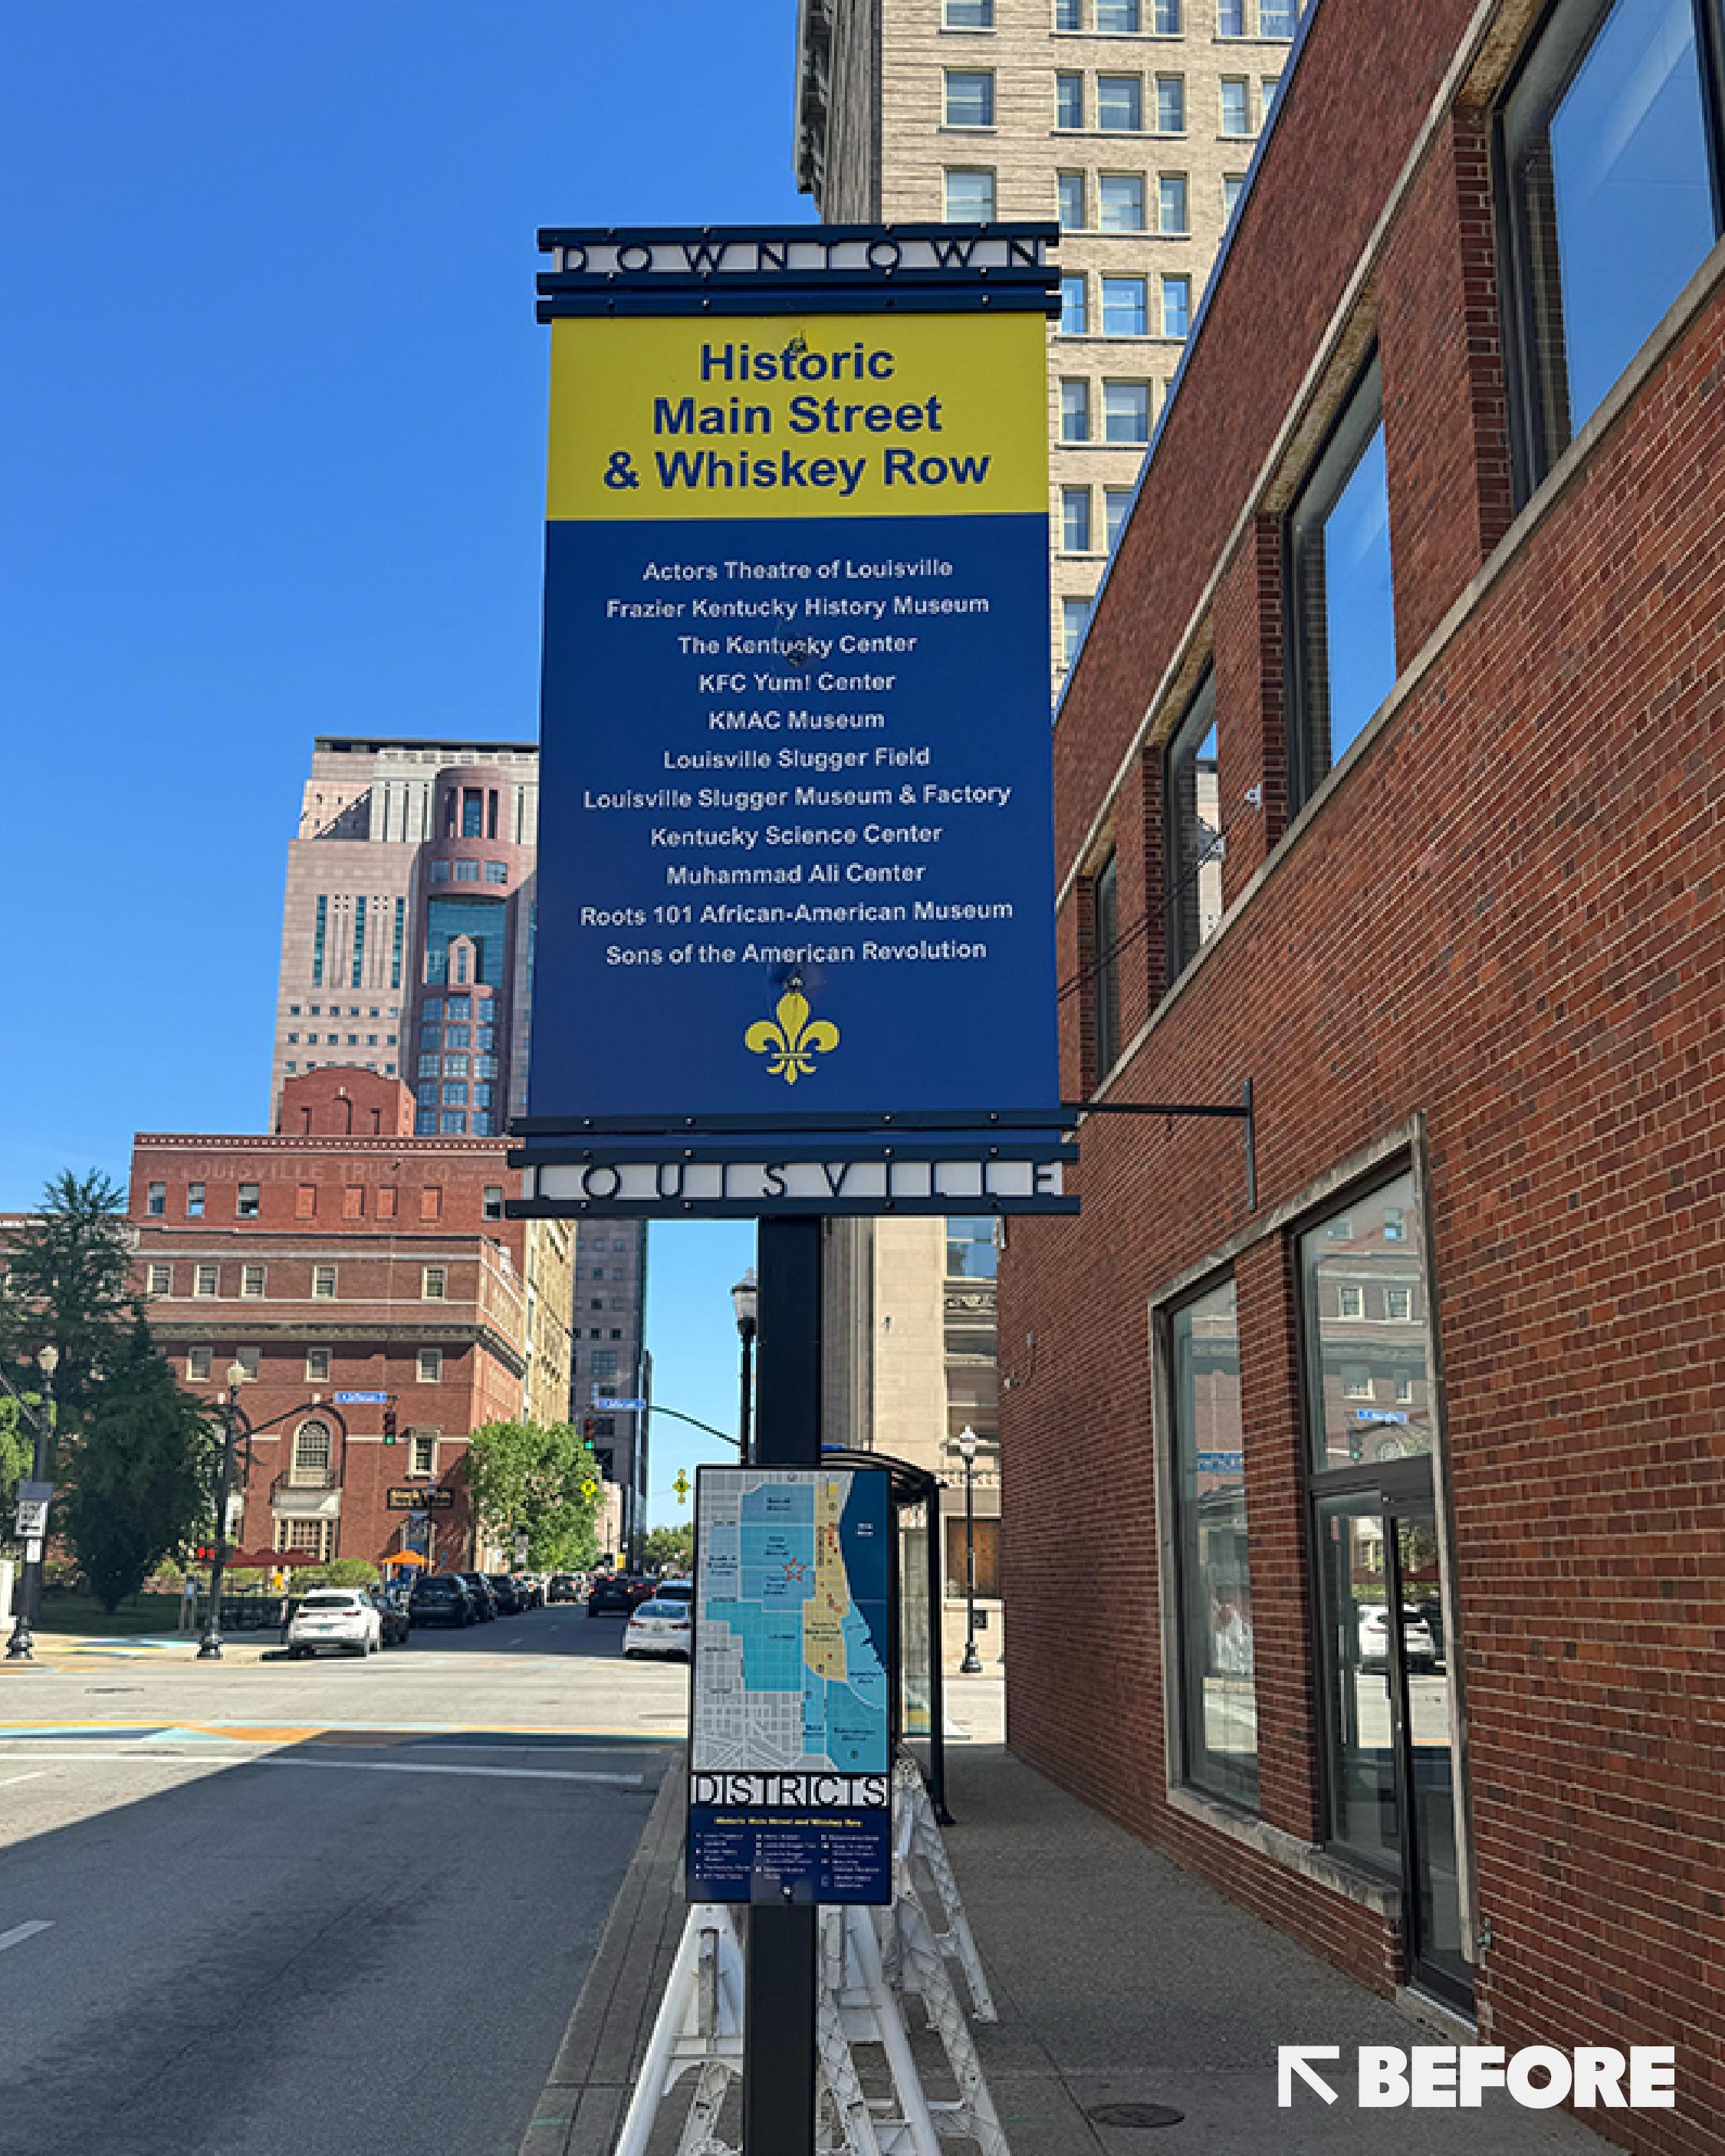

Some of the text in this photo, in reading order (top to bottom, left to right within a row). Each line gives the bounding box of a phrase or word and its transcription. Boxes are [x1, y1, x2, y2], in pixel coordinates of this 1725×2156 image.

[561, 239, 1038, 271] DOWNTOWN
[700, 342, 895, 380] Historic
[653, 395, 942, 435] Main Street
[603, 449, 991, 496] & Whiskey Row
[642, 558, 953, 581] Actors Theatre of Louisville
[606, 595, 990, 620] Frazier Kentucky History Museum
[677, 635, 918, 659] The Kentucky Center
[699, 671, 896, 693] KFC Yum! Center
[708, 710, 886, 730] KMAC Museum
[662, 746, 930, 771] Louisville Slugger Field
[584, 784, 1011, 811] Louisville Slugger Museum & Factory
[650, 823, 943, 850] Kentucky Science Center
[665, 862, 927, 885] Muhammad Ali Center
[580, 900, 1014, 926] Roots 101 African-American Museum
[606, 939, 987, 965] Sons of the American Revolution
[536, 1162, 1062, 1198] LOUISVILLE
[695, 1773, 886, 1806] DISTRICTS
